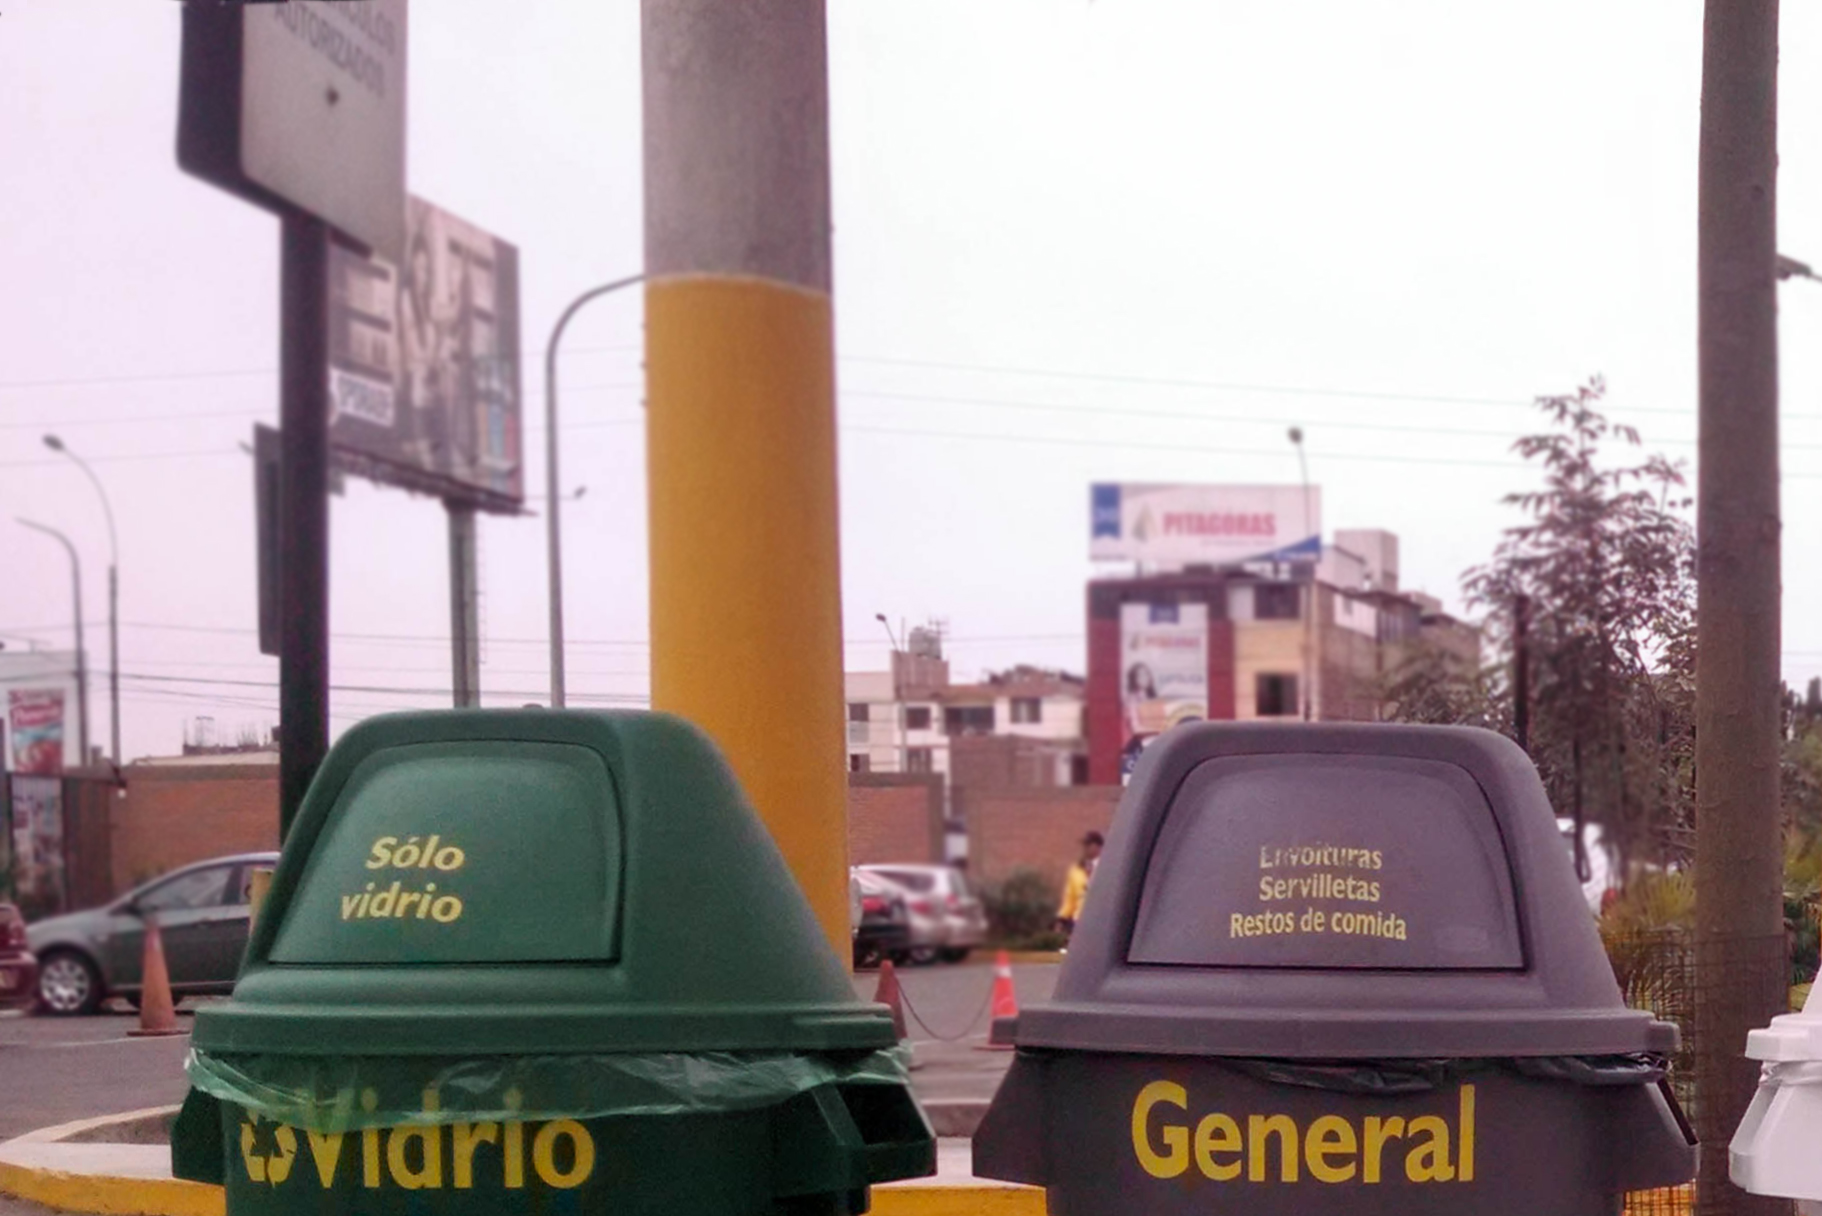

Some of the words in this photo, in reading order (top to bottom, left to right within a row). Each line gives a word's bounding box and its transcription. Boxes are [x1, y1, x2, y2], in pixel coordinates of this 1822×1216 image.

[365, 834, 466, 871] Sólo
[341, 880, 463, 923] vidrio
[1259, 873, 1381, 902] Servilletas
[1230, 909, 1295, 938] Restos
[1300, 906, 1326, 932] de
[1331, 909, 1407, 940] comida
[296, 1087, 596, 1190] Vidrio
[1131, 1080, 1476, 1183] General
